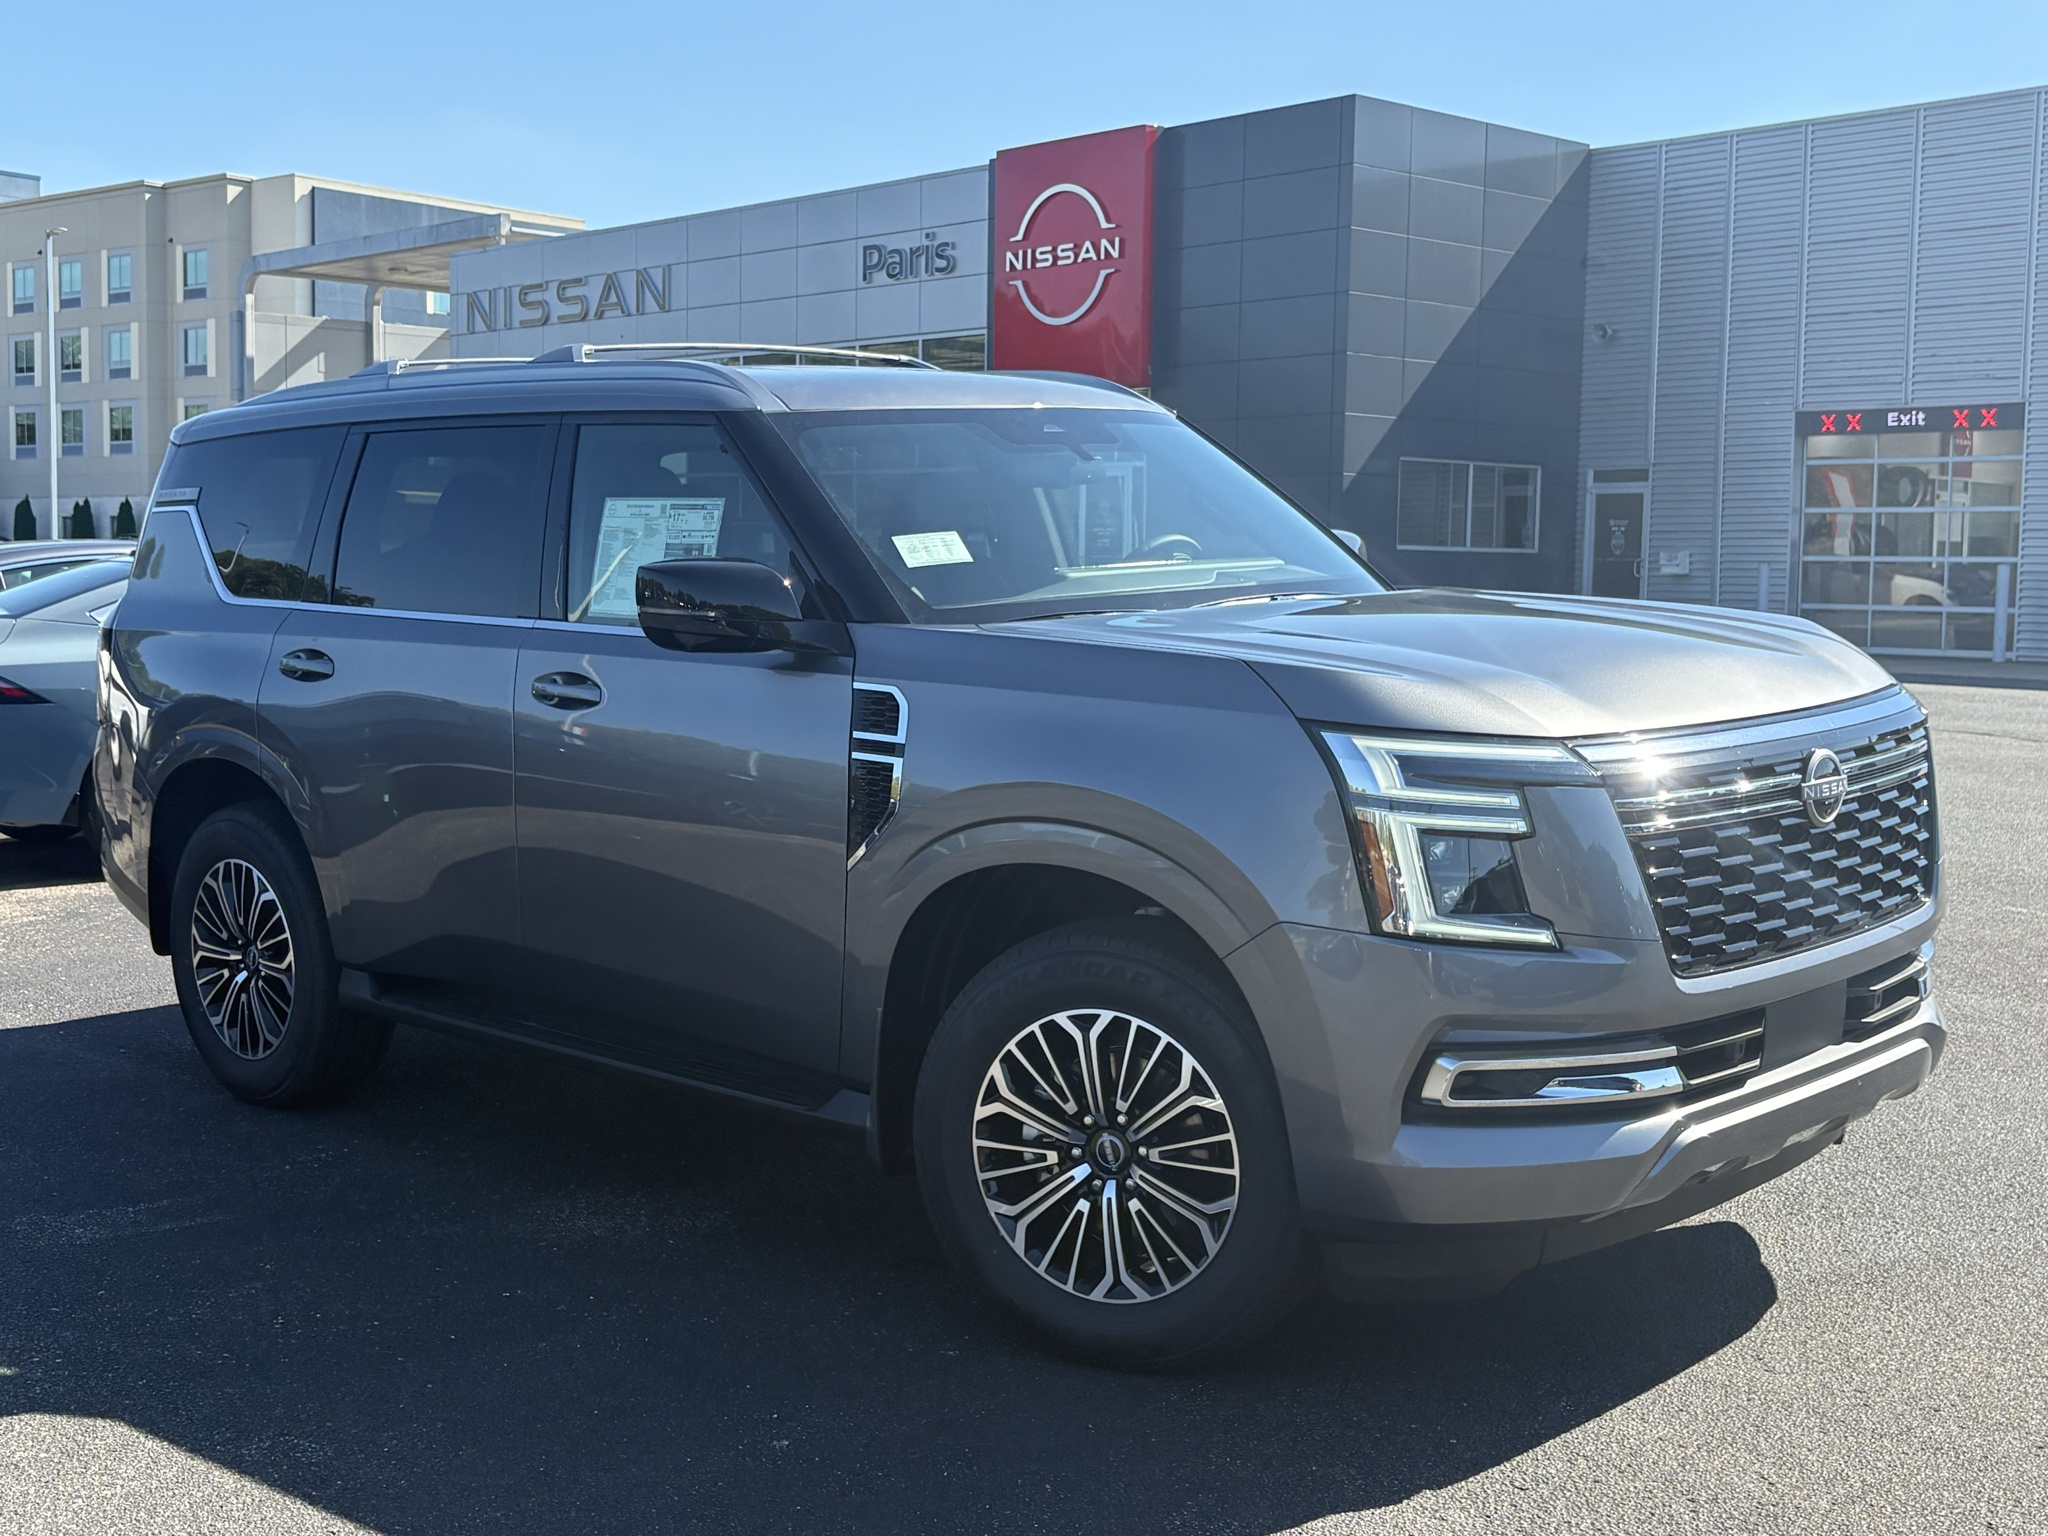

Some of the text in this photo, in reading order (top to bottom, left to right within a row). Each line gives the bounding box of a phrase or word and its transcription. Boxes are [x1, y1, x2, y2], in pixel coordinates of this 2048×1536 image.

[862, 231, 957, 284] Paris
[1005, 236, 1120, 273] NISSAN
[466, 264, 671, 335] NISSAN
[1886, 410, 1926, 427] Exit
